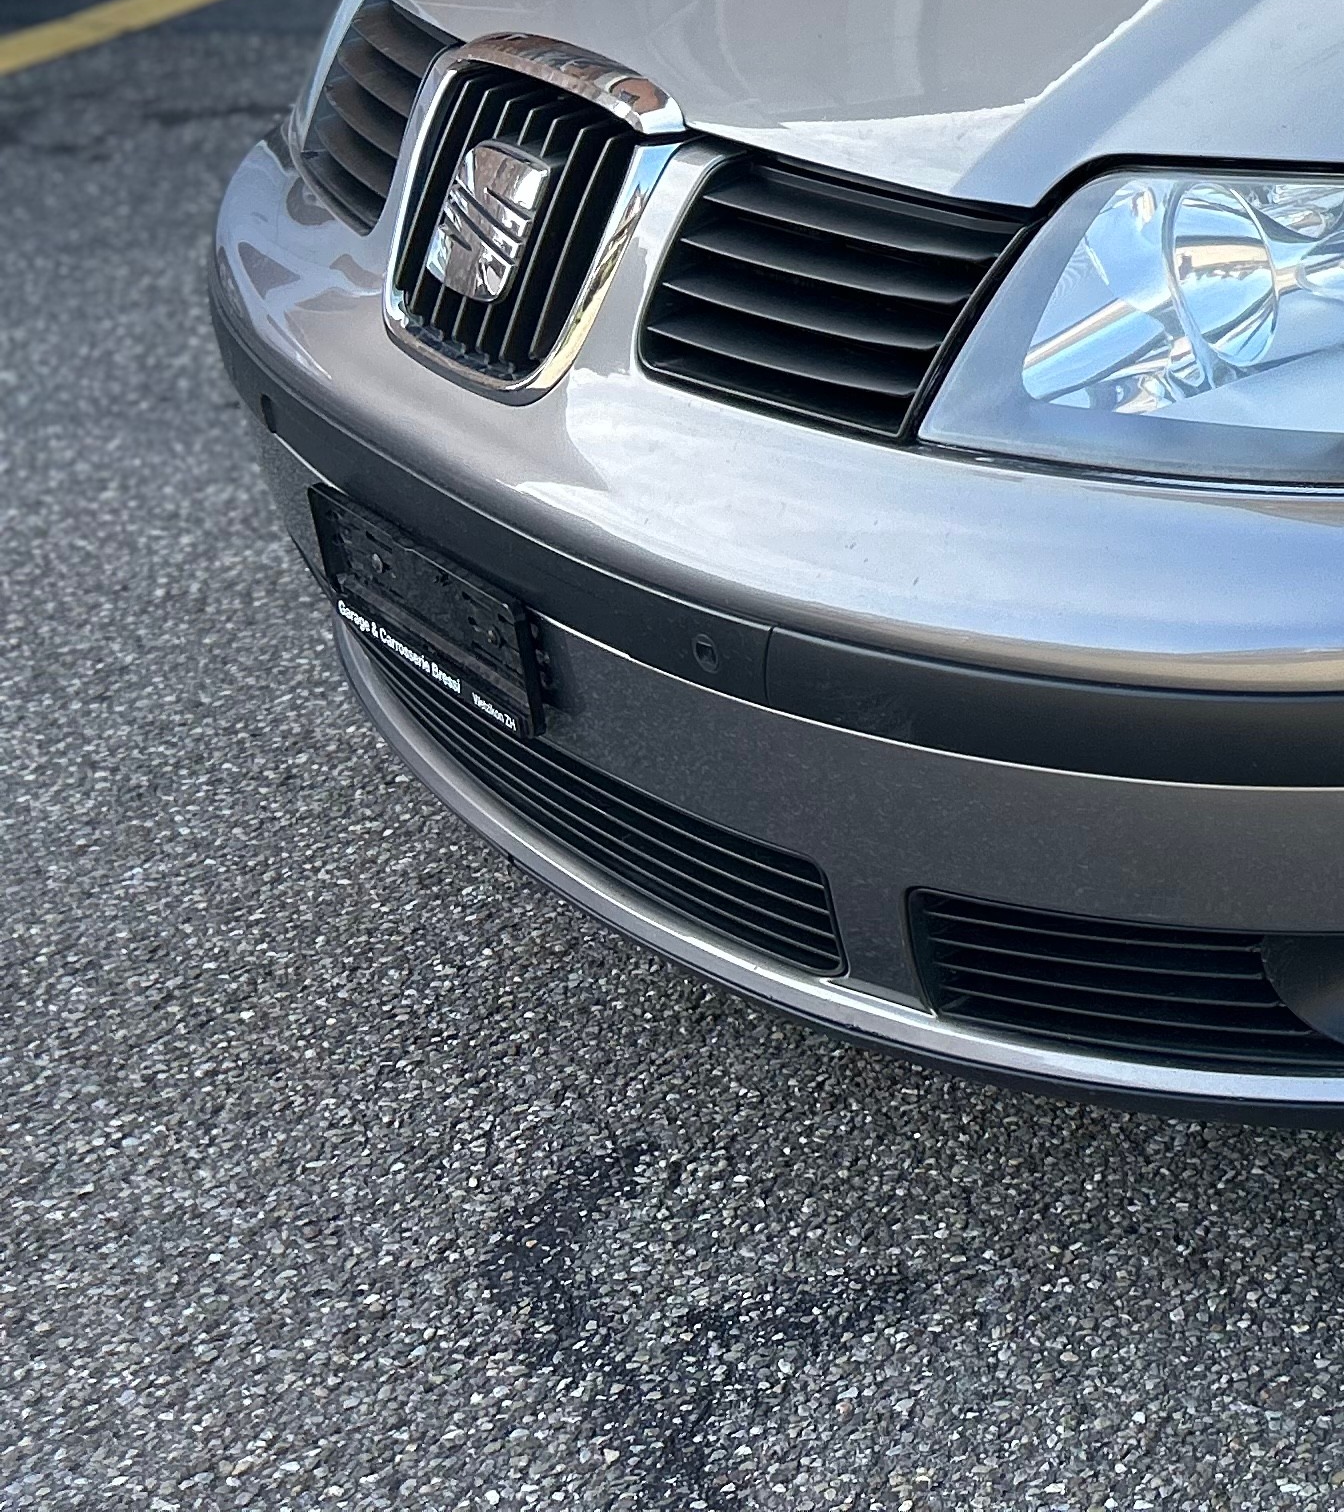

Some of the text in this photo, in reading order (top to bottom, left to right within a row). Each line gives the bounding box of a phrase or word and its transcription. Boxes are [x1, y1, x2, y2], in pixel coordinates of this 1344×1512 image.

[338, 600, 371, 632] Garage
[371, 621, 379, 638] &
[380, 628, 431, 673] Carrosserie
